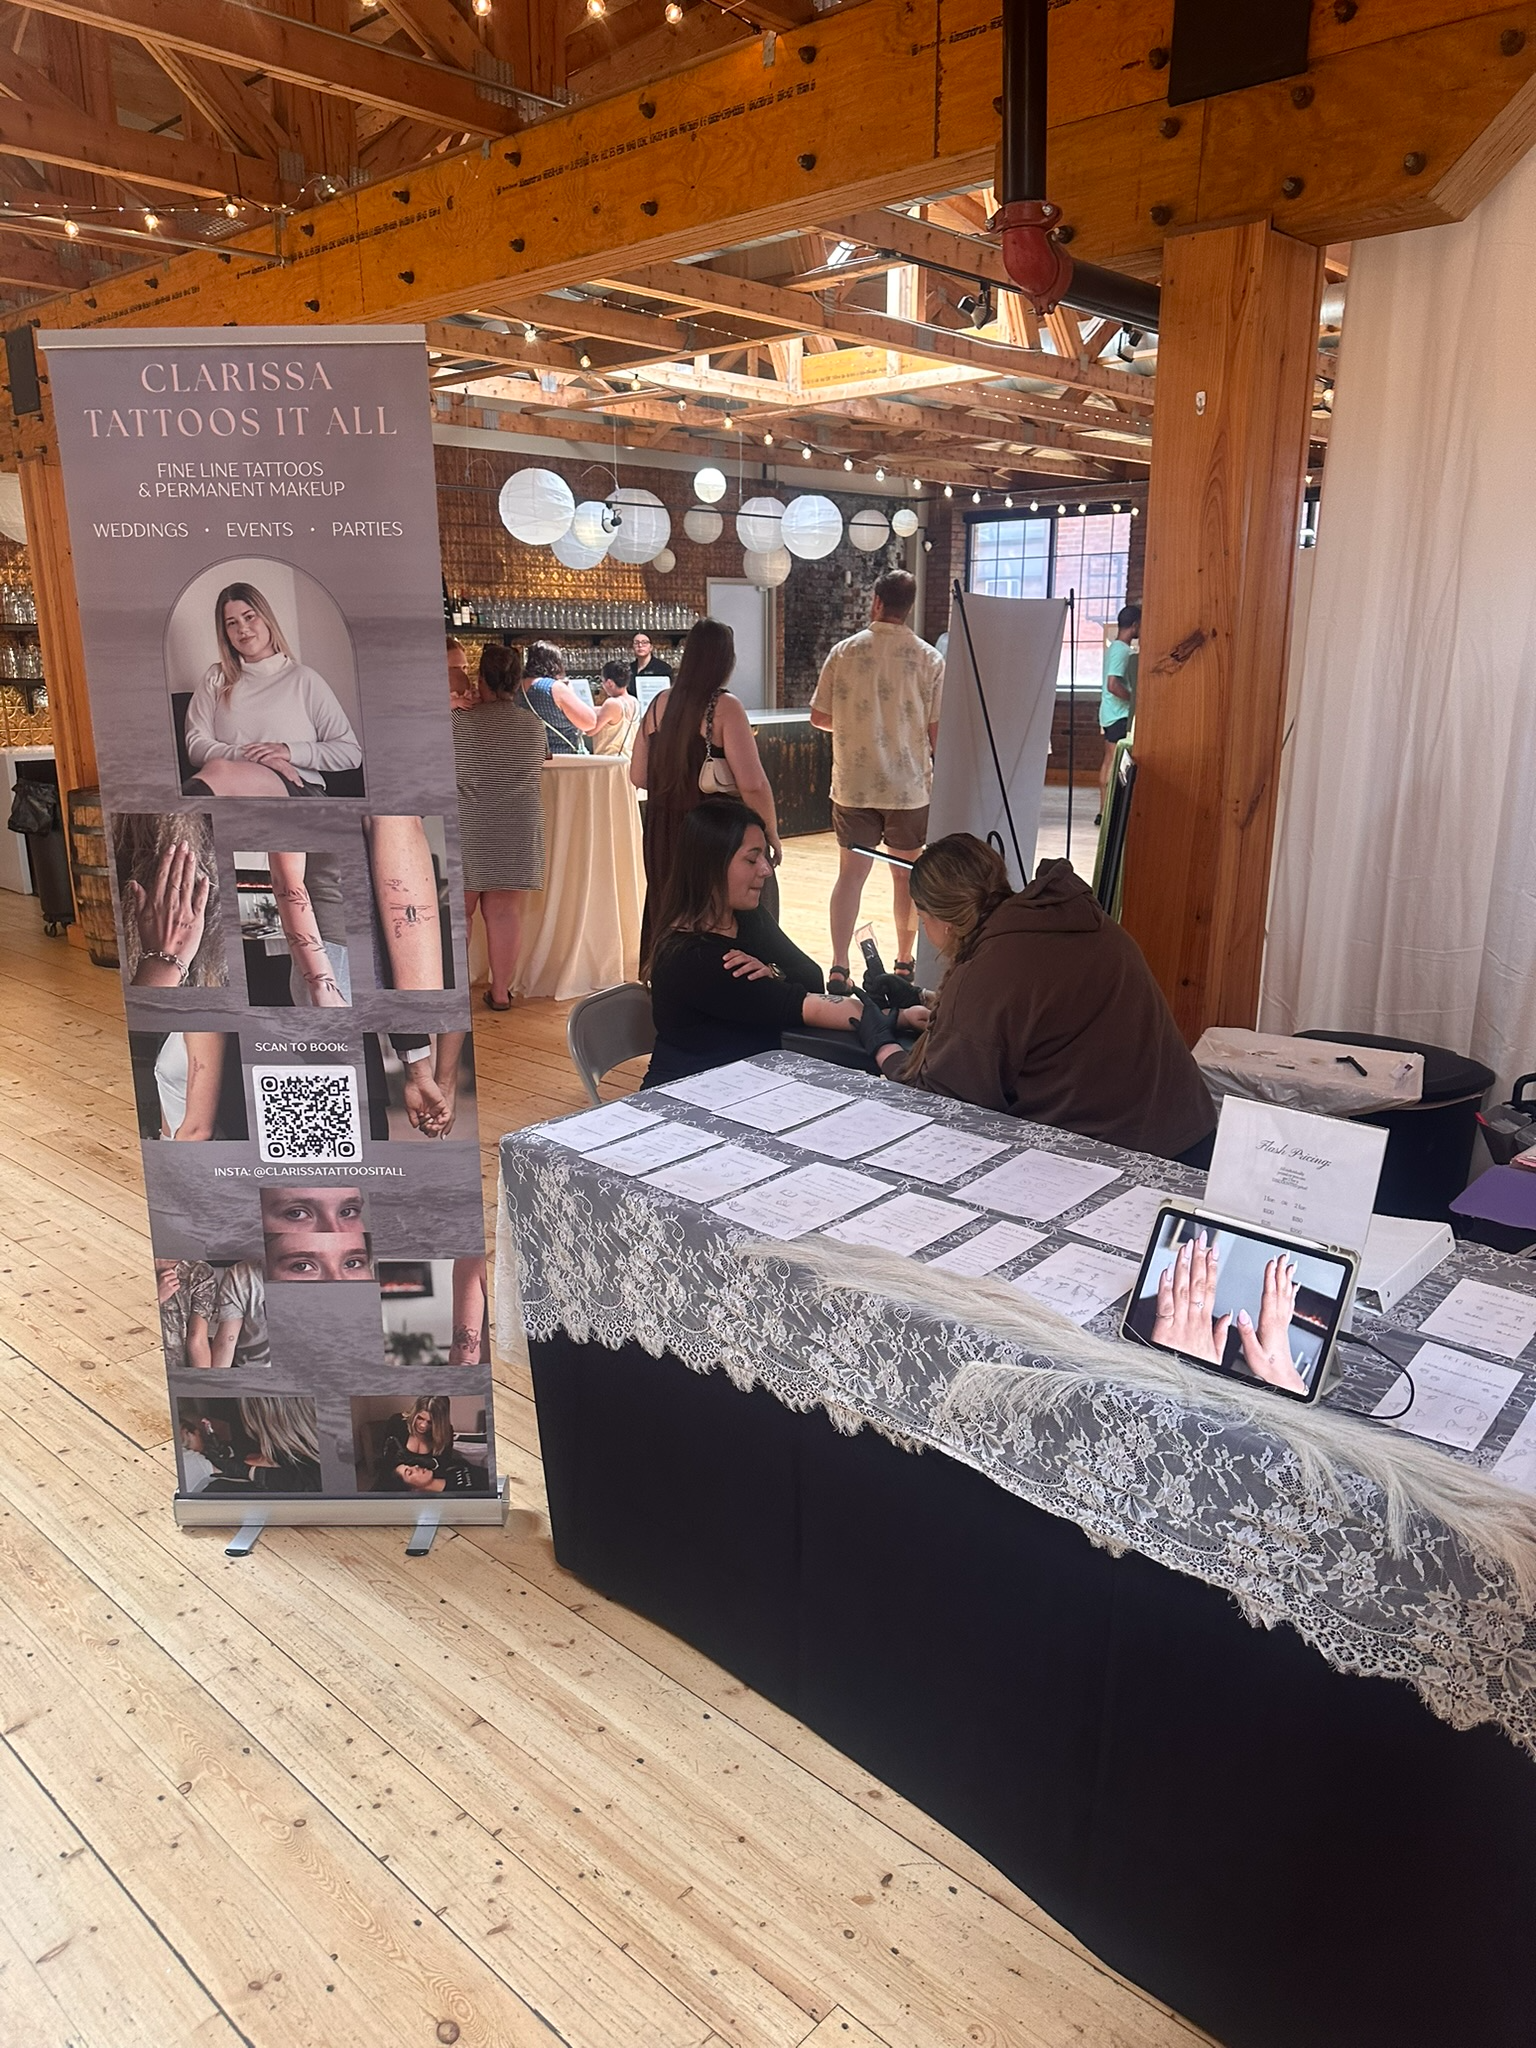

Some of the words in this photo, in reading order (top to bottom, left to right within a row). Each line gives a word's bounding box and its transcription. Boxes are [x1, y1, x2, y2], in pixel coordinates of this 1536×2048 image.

[140, 360, 334, 393] CLARISSA
[84, 407, 262, 438] TATTOOS
[276, 406, 310, 437] IT
[326, 405, 398, 436] ALL
[157, 461, 197, 479] FINE
[200, 461, 240, 478] LINE
[242, 460, 324, 478] TATTOOS
[137, 482, 152, 498] &
[155, 481, 265, 498] PERMANENT
[269, 480, 346, 497] MAKEUP
[93, 521, 189, 538] WEDDINGS
[226, 521, 294, 537] EVENTS
[332, 520, 404, 537] PARTIES
[255, 1042, 288, 1052] SCAN
[289, 1042, 308, 1052] TO
[310, 1042, 349, 1052] BOOK:
[1255, 1139, 1288, 1156] Flash
[1288, 1147, 1332, 1170] Pricing:
[214, 1167, 252, 1177] INSTA:
[253, 1166, 407, 1179] @CLARISSATATTOOSITALL
[1463, 1360, 1493, 1373] FLASH
